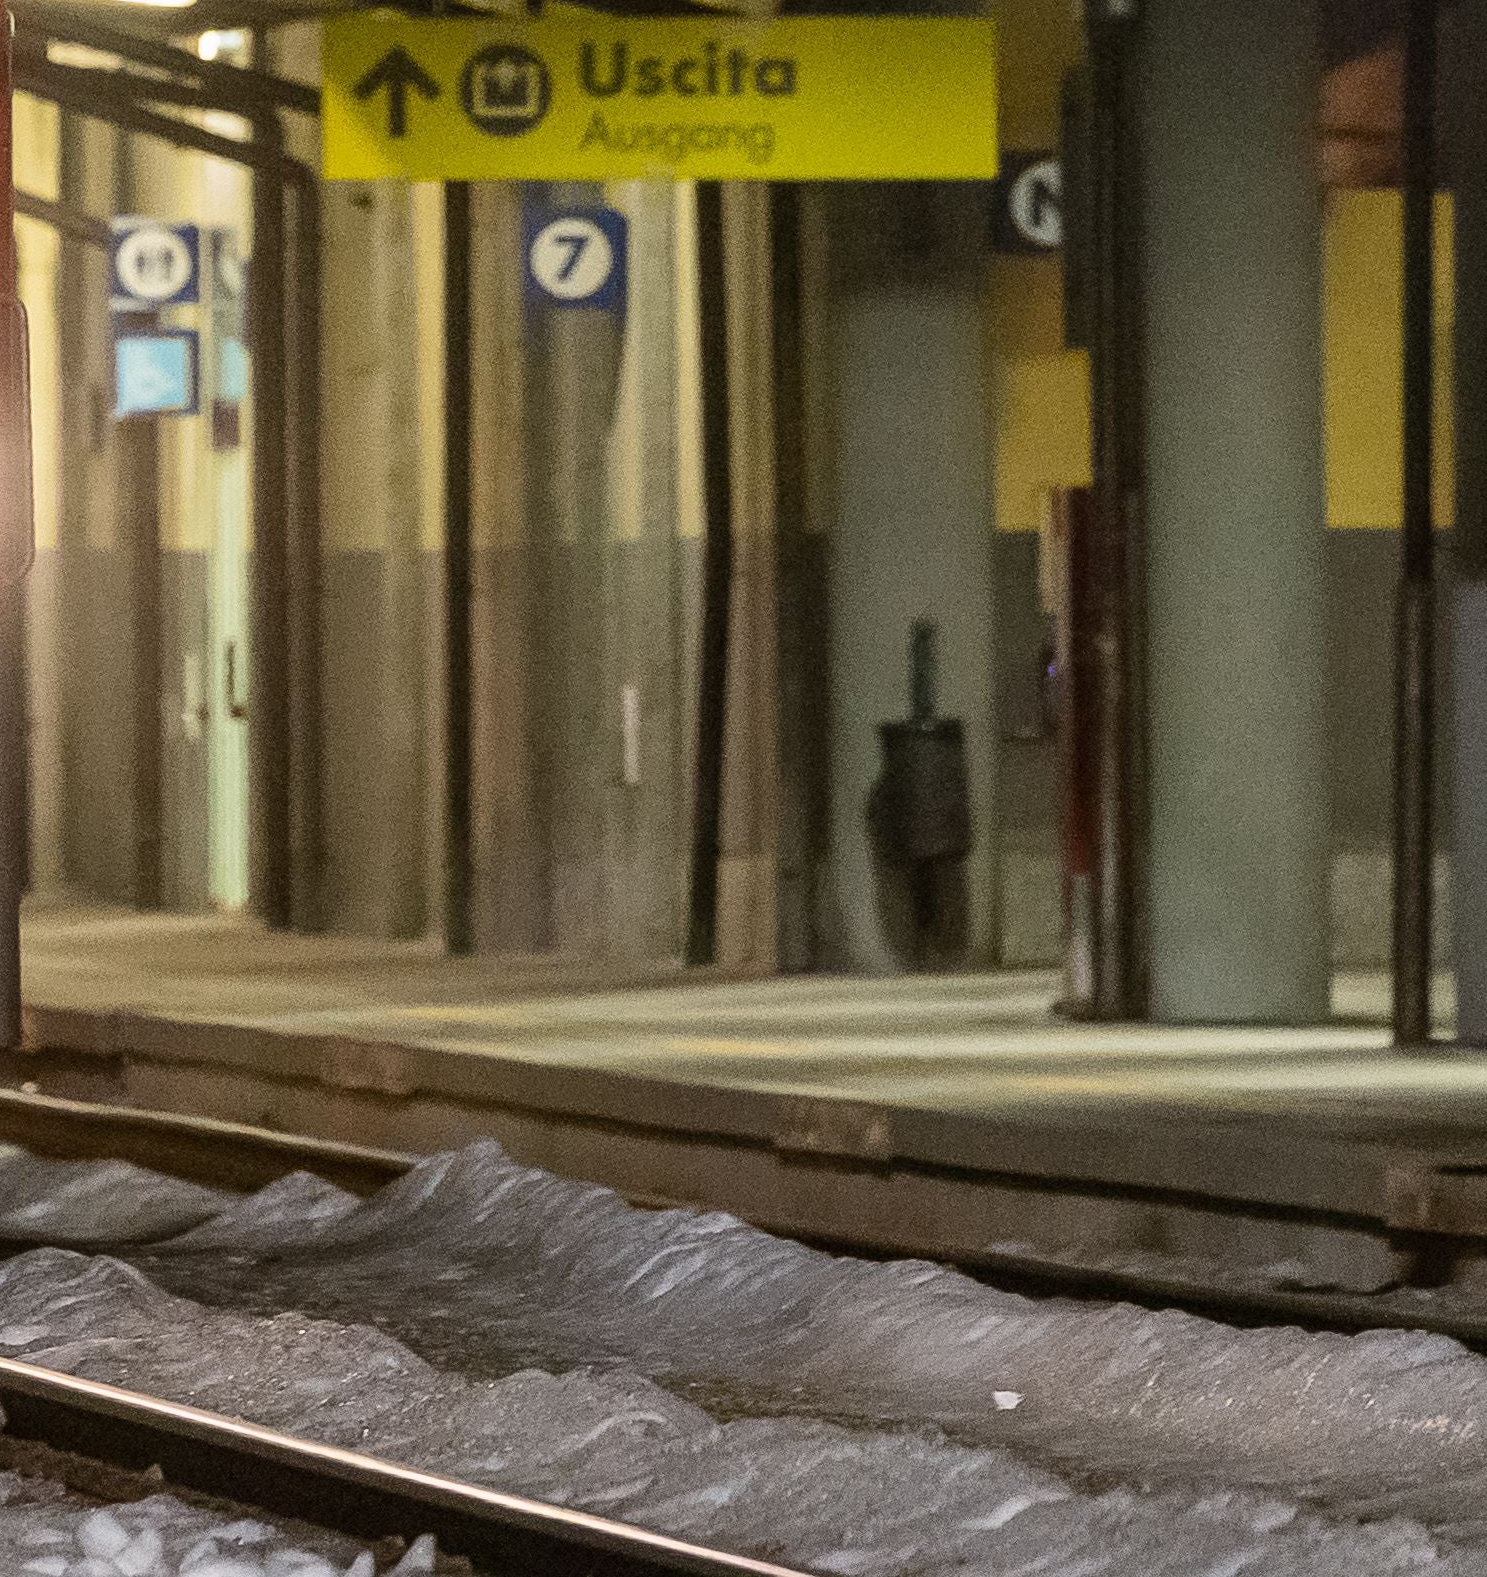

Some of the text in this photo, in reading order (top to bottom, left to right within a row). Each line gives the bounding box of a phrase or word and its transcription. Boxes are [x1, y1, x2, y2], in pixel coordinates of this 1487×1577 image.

[580, 39, 798, 98] Uscita
[580, 113, 777, 164] Ausgang
[554, 235, 590, 283] 7
